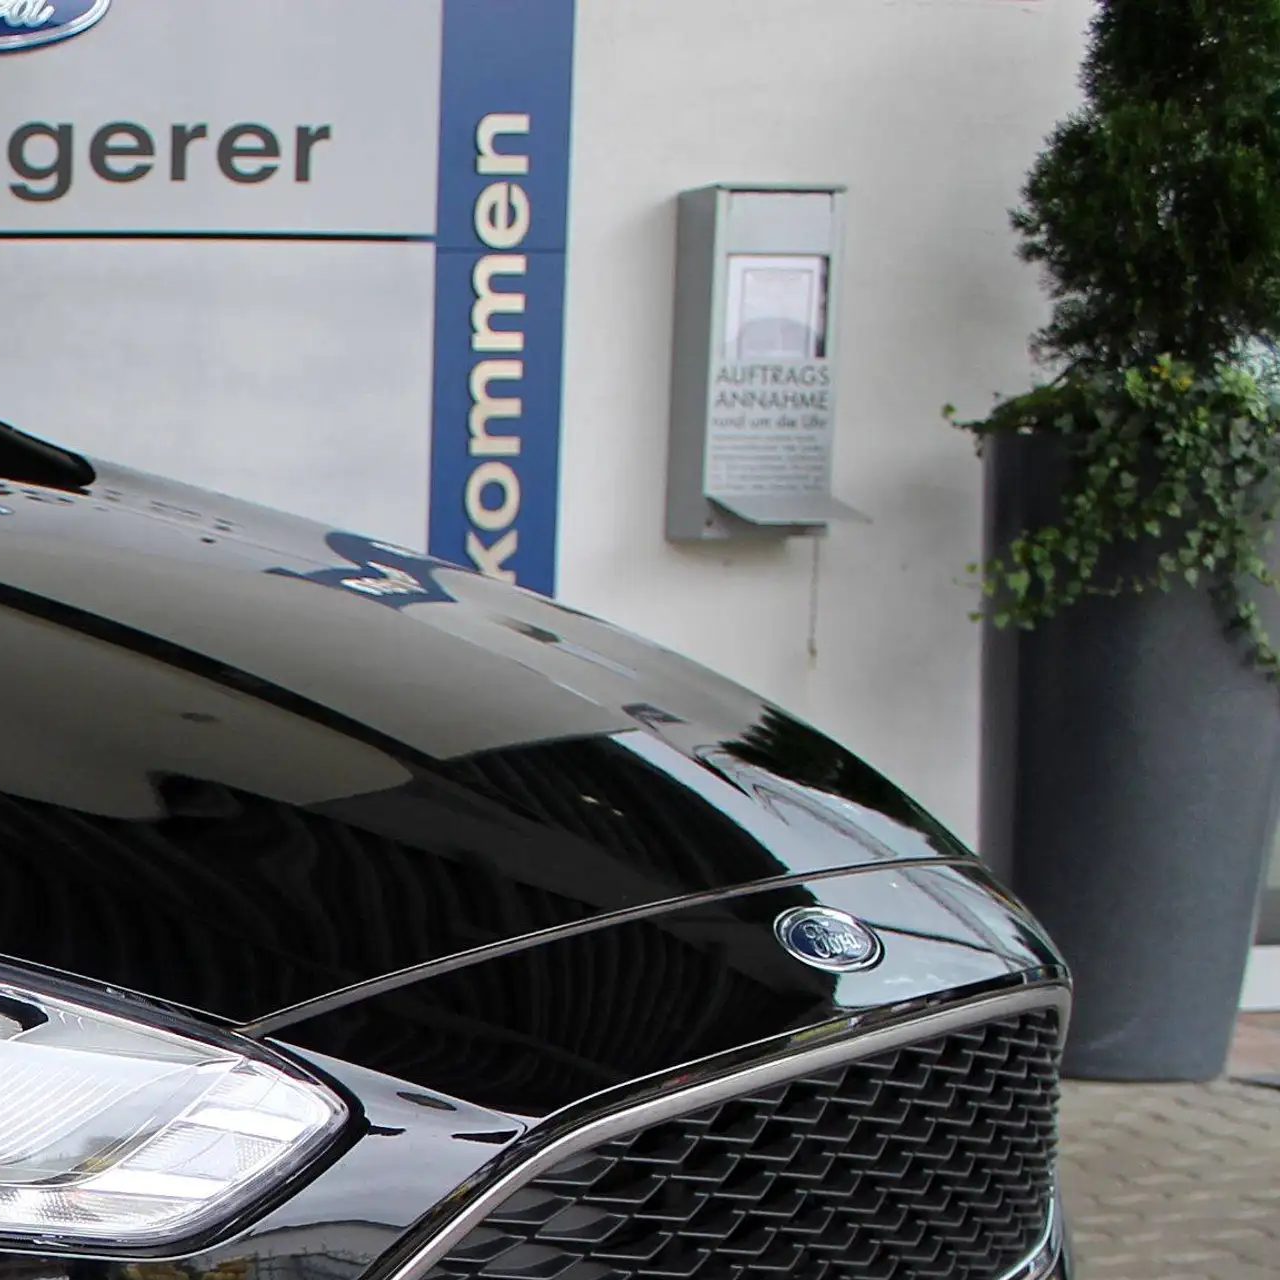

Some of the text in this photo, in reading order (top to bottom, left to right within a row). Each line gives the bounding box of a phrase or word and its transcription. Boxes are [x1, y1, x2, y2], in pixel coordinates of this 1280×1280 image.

[716, 364, 830, 386] AUFTRAGS
[715, 389, 829, 411] ANNAHME
[801, 921, 862, 958] Ford
